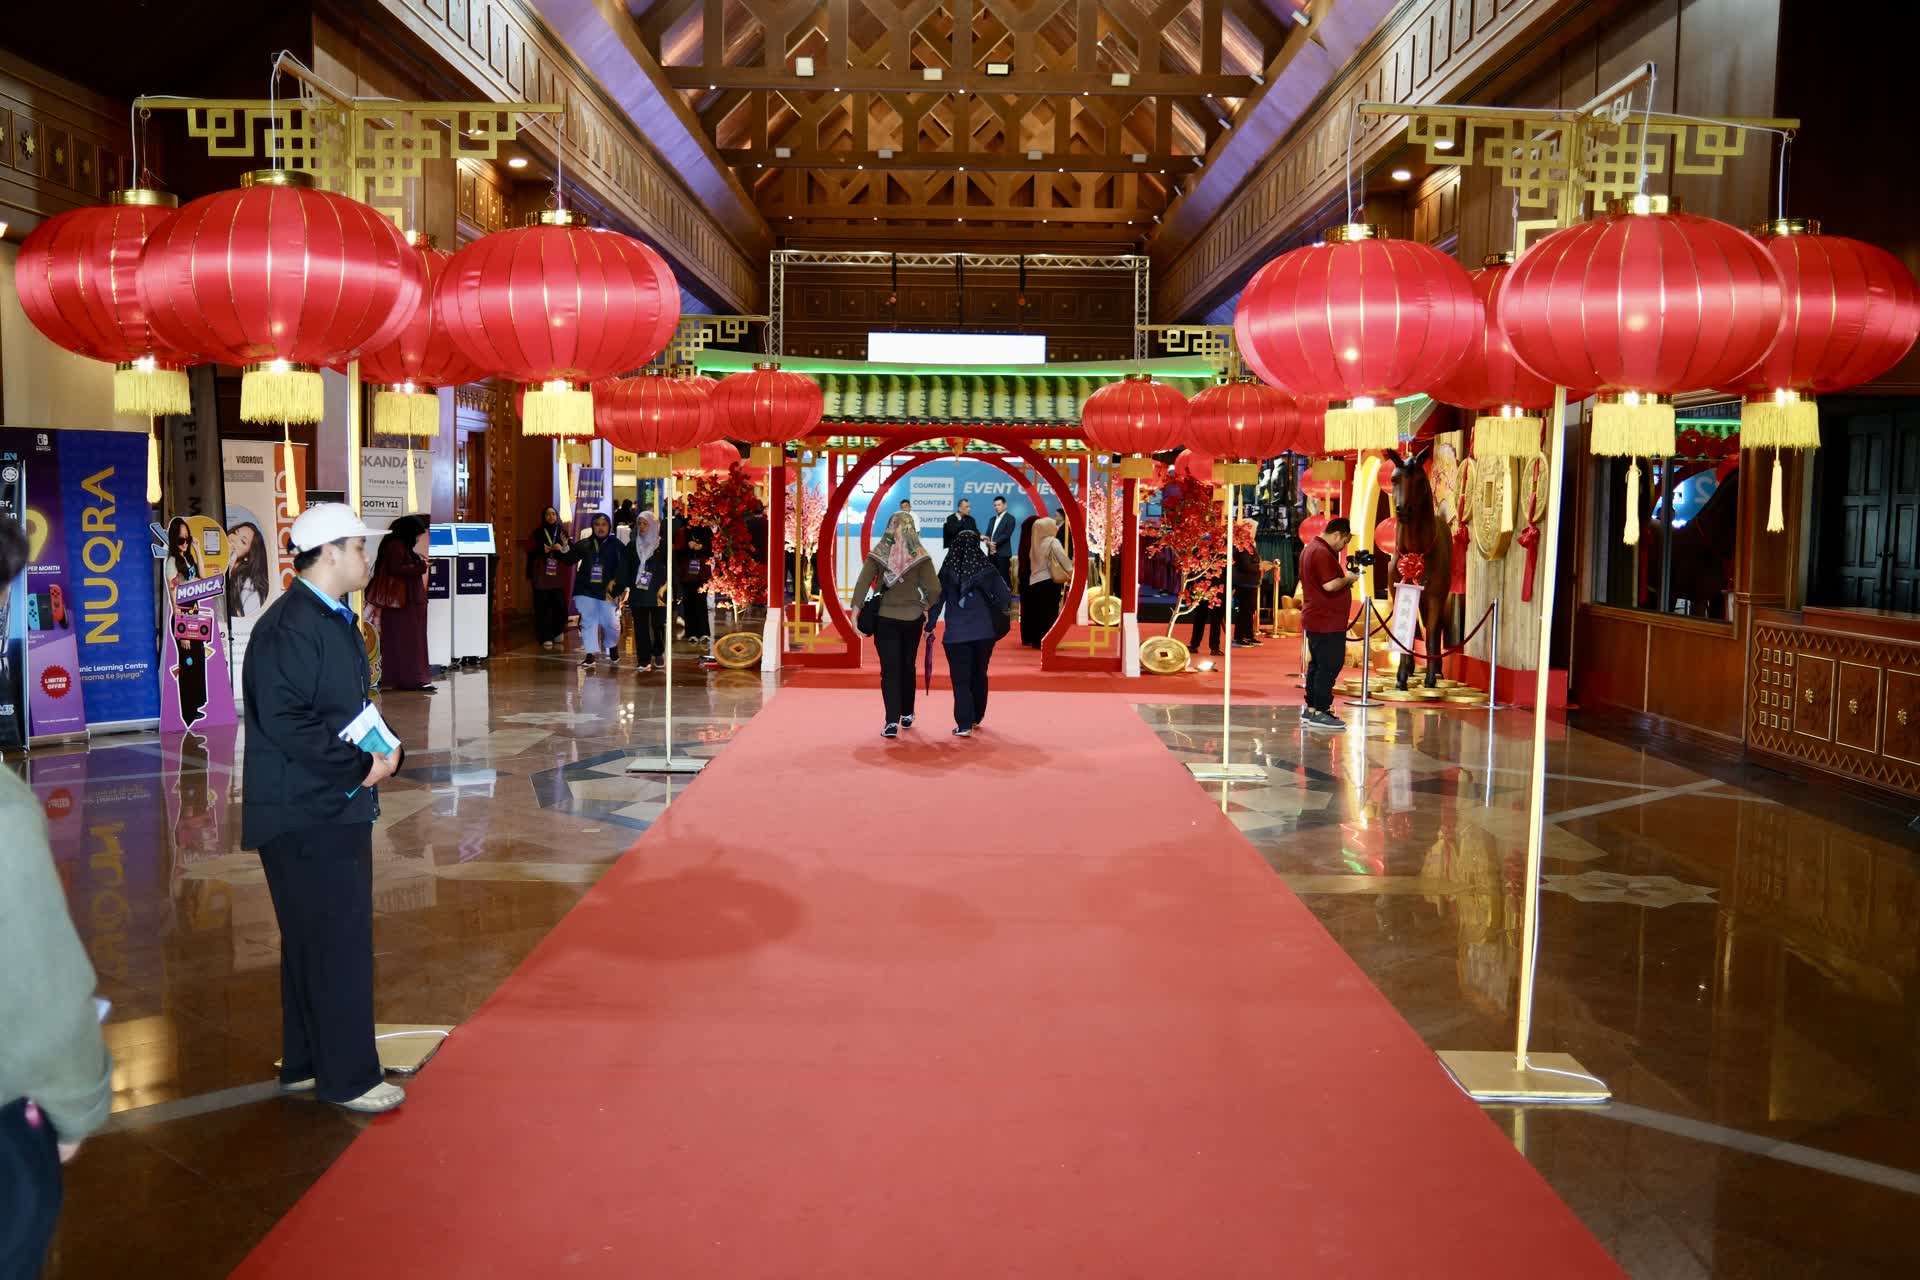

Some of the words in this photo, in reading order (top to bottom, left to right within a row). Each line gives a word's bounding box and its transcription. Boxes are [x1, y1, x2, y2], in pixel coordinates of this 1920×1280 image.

[236, 456, 264, 465] VIGOROUS
[963, 482, 1016, 495] EVENT
[362, 500, 384, 508] OOTH
[81, 465, 123, 645] NUQRA
[177, 578, 222, 600] MONICA
[94, 663, 124, 672] Learning
[124, 662, 148, 670] Centre
[44, 676, 68, 684] LIMITED
[81, 673, 105, 681] rsama
